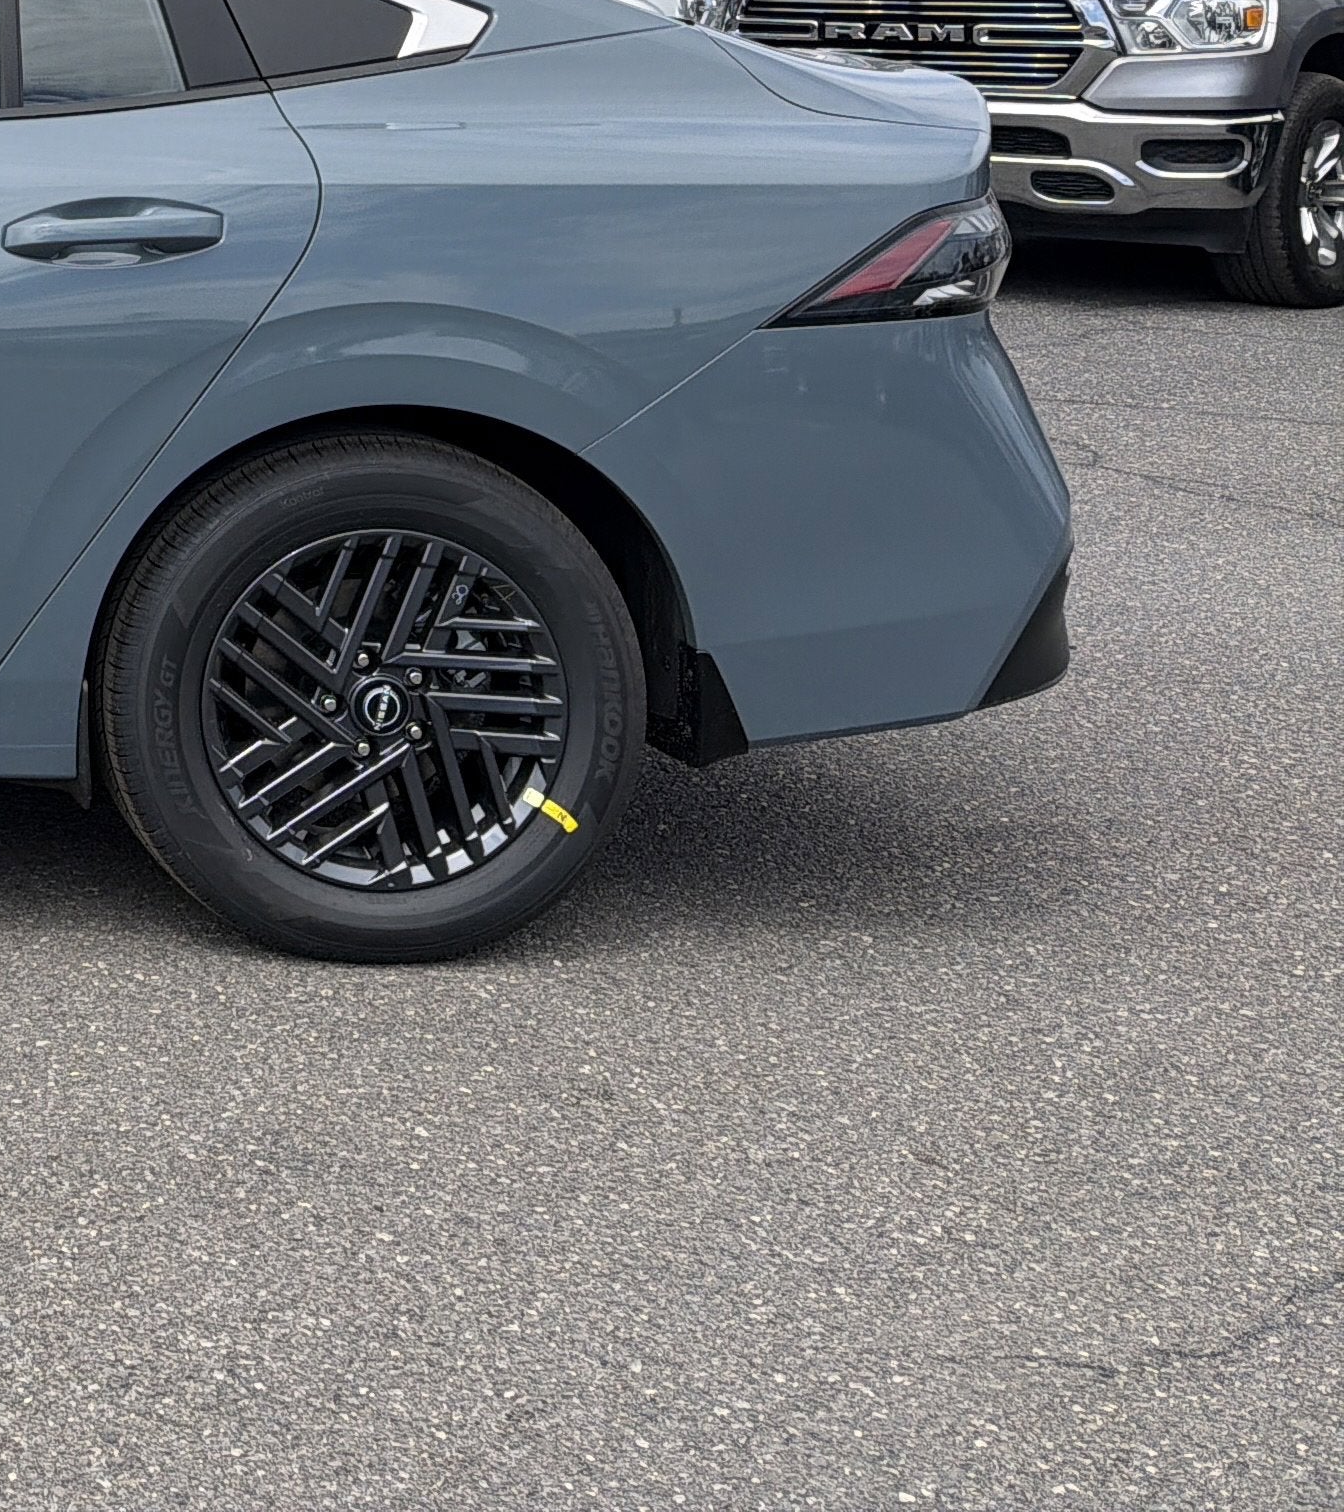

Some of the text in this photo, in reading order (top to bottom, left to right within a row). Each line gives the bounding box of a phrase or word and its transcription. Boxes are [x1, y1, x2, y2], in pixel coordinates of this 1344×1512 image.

[824, 21, 965, 42] RAM
[159, 653, 177, 688] GT
[373, 684, 392, 731] NISSAN
